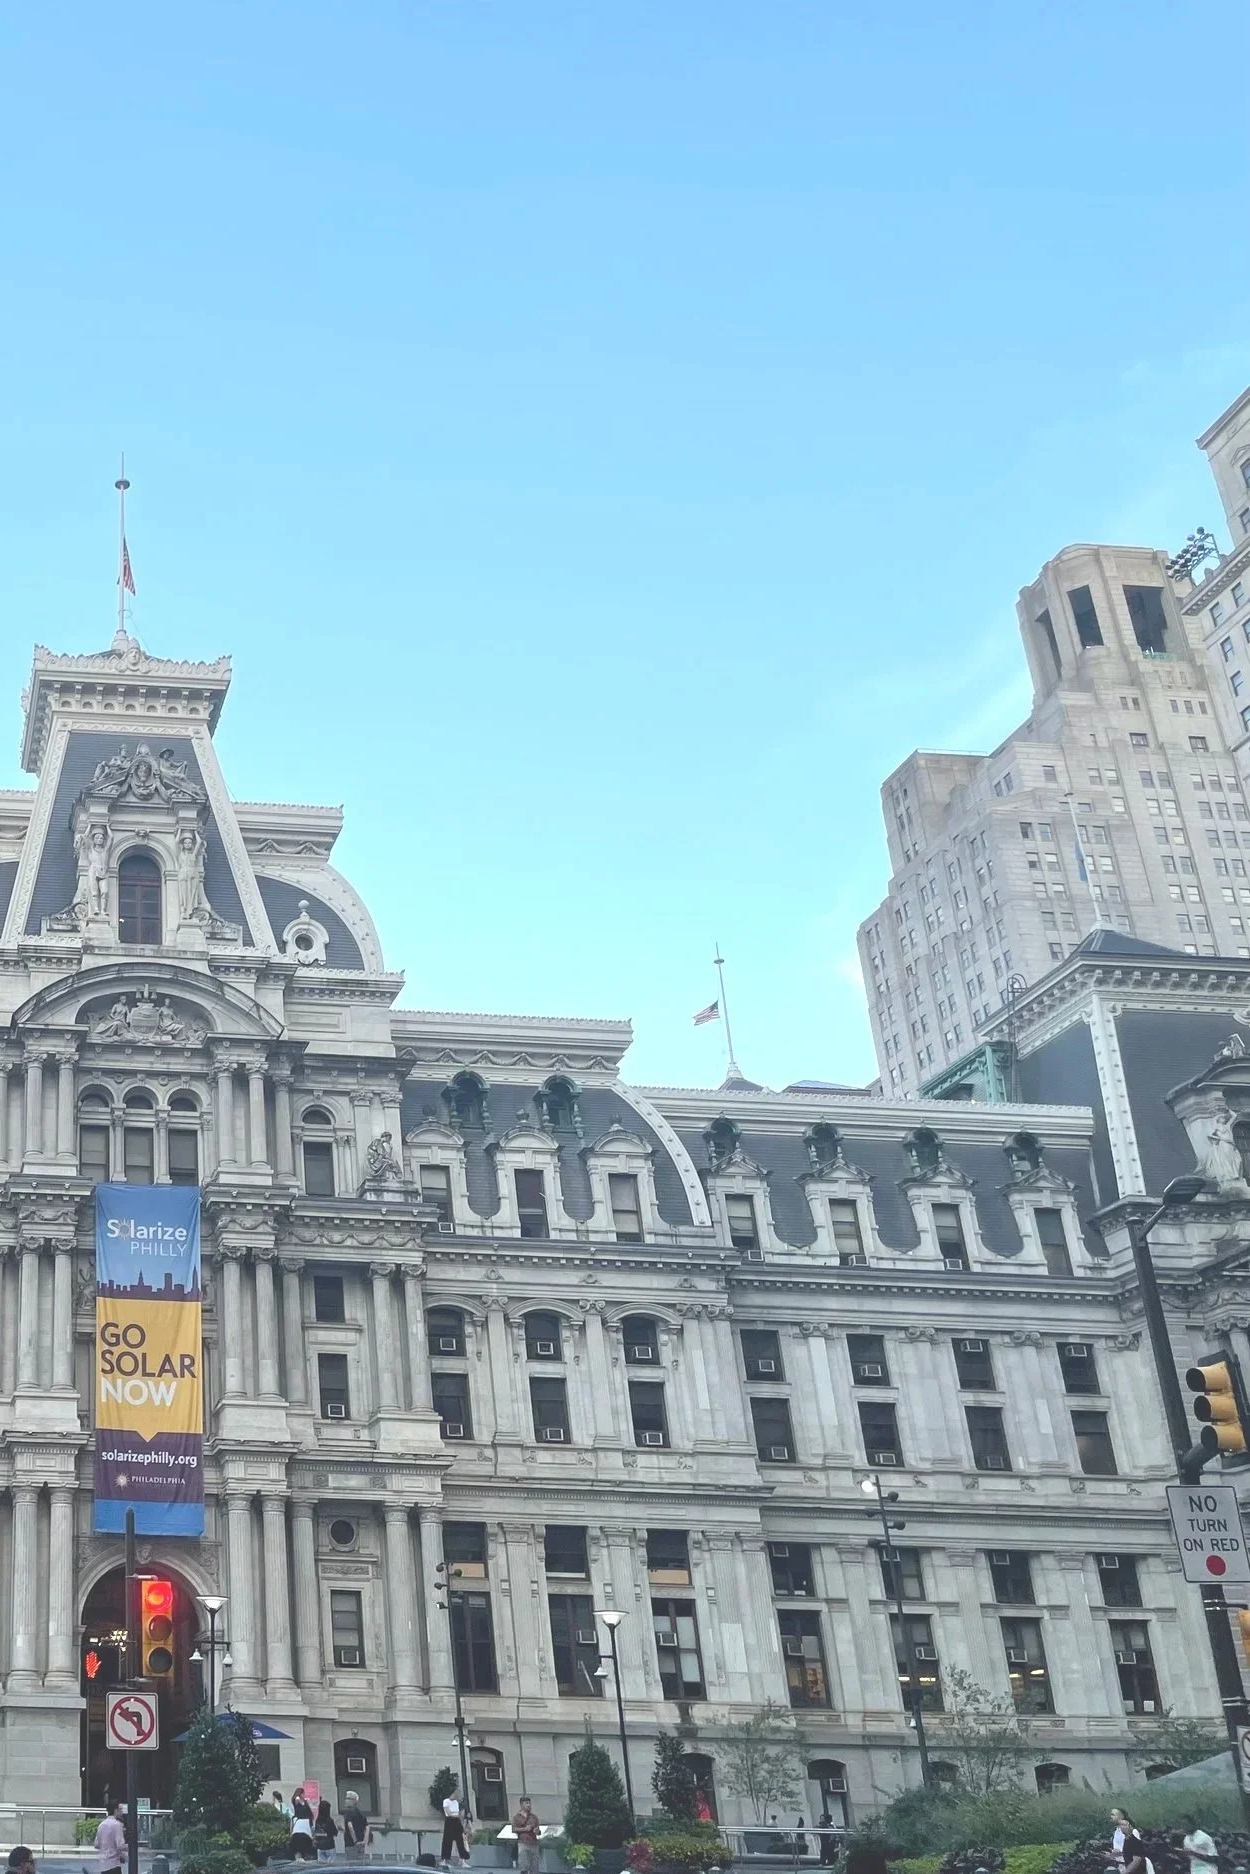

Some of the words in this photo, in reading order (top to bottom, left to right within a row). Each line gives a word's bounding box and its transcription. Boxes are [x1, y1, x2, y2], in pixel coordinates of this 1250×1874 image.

[130, 1241, 187, 1257] PHILLY
[100, 1322, 146, 1349] GO
[101, 1349, 197, 1378] SOLAR
[101, 1376, 177, 1406] NOW
[101, 1449, 198, 1468] solarizephilly.org
[131, 1475, 186, 1485] PHILADELPHIA
[1188, 1495, 1217, 1512] NO
[1187, 1519, 1228, 1532] TURN
[1183, 1539, 1204, 1551] ON
[1210, 1539, 1240, 1551] RED
